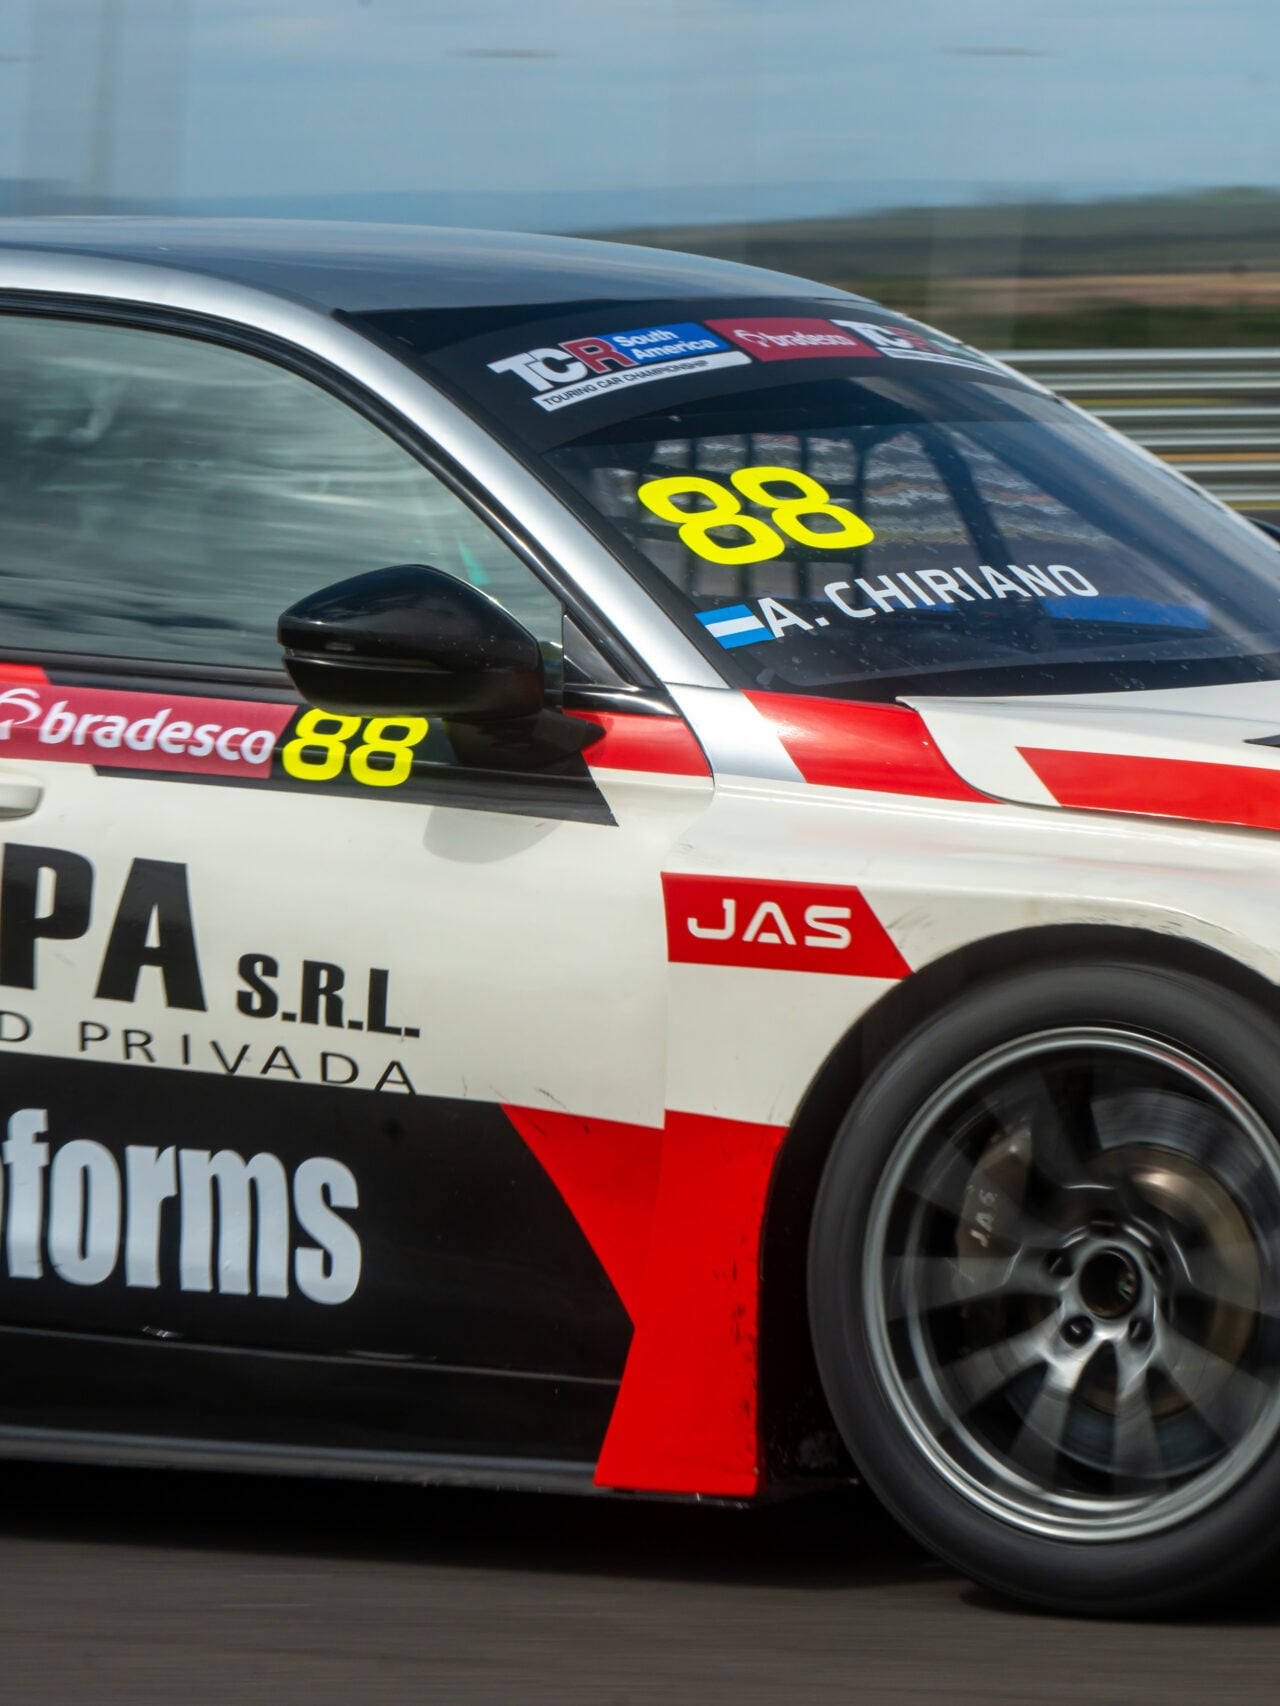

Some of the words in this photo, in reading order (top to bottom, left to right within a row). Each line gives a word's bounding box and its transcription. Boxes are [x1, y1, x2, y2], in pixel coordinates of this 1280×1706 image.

[486, 336, 640, 392] TCR
[613, 330, 680, 347] South
[631, 339, 719, 361] America
[541, 384, 597, 407] TOURING
[597, 376, 624, 390] CAR
[623, 360, 709, 383] CHAMPIONSHIP
[638, 466, 875, 565] 88
[757, 597, 830, 638] A.
[824, 564, 1099, 618] CHIRIANO
[39, 700, 275, 765] bradesco
[282, 708, 429, 787] 88
[0, 842, 207, 1012] PA
[687, 898, 852, 949] JAS
[236, 953, 420, 1038] S.R.L.
[79, 1021, 416, 1096] PRIVADA
[0, 1108, 362, 1305] forms
